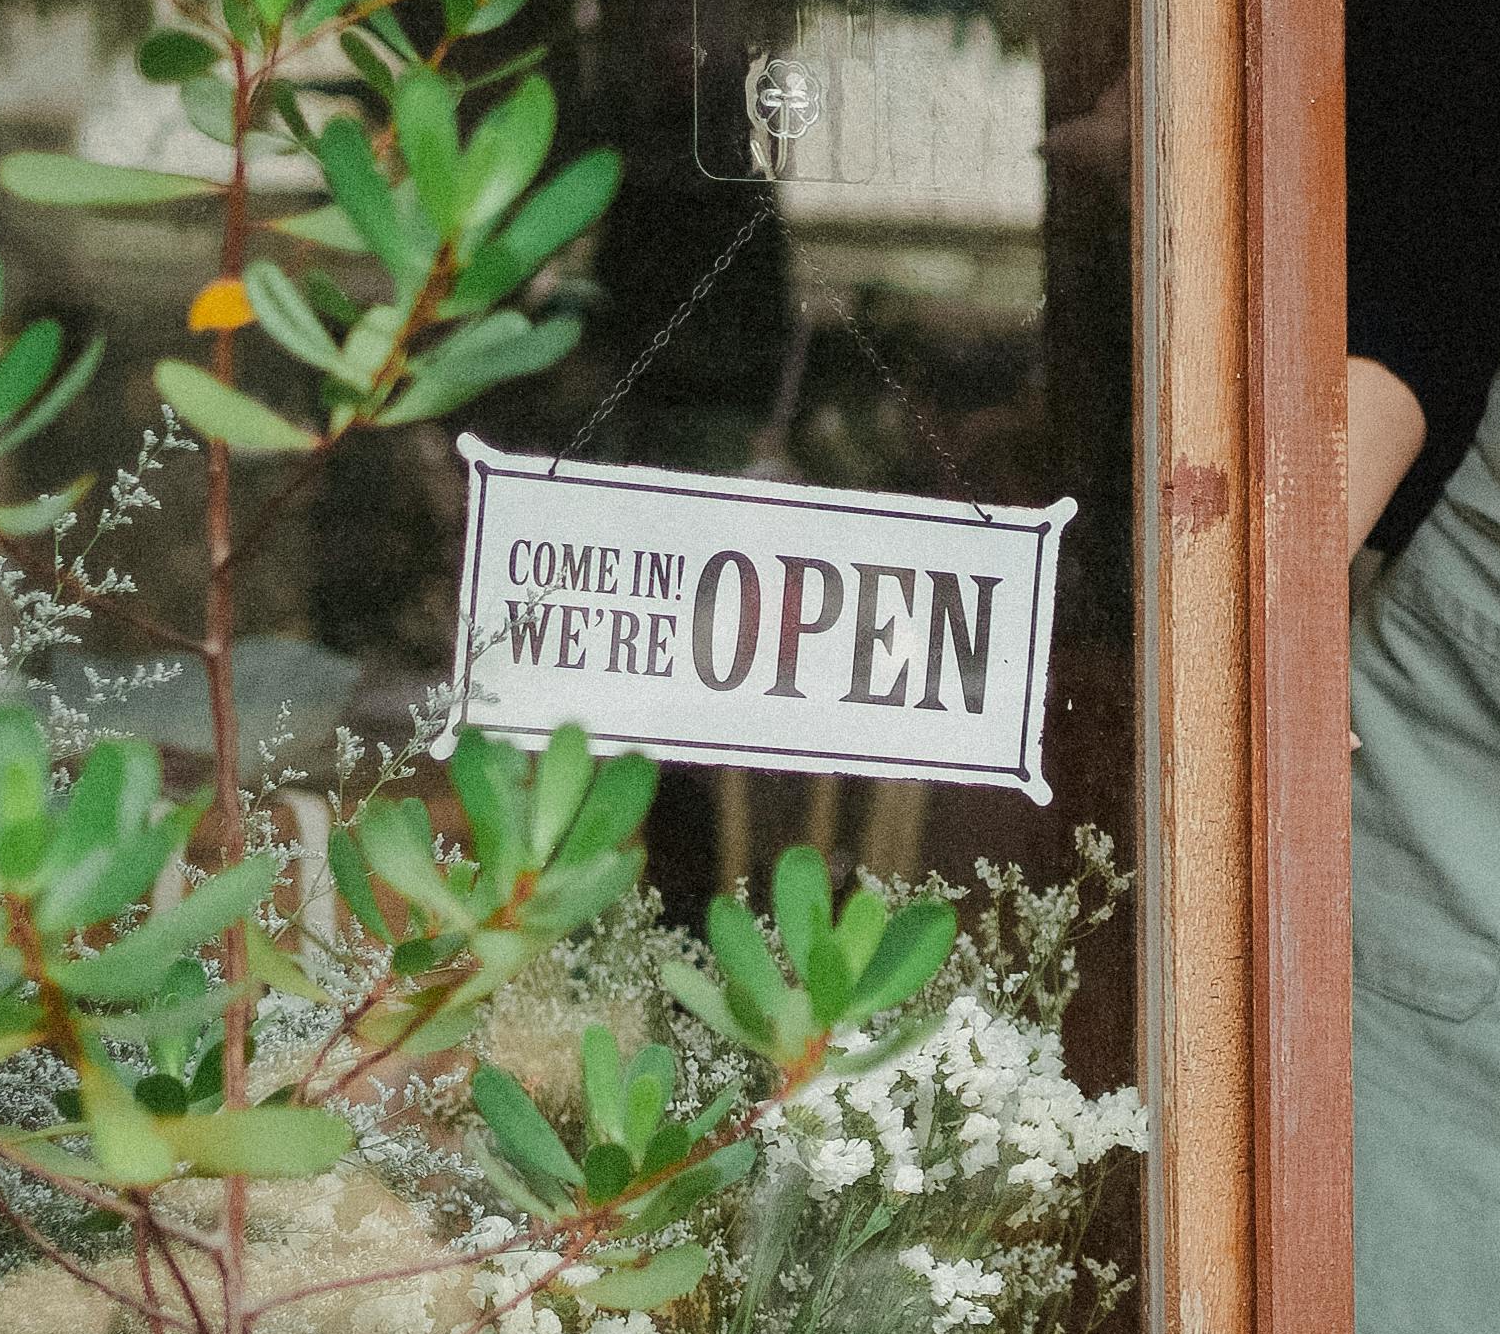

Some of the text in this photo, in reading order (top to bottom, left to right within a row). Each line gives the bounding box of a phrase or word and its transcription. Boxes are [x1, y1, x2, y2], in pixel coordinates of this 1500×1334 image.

[508, 538, 687, 601] COME IN!
[506, 599, 678, 678] WE'RE
[691, 549, 1004, 715] OPEN
